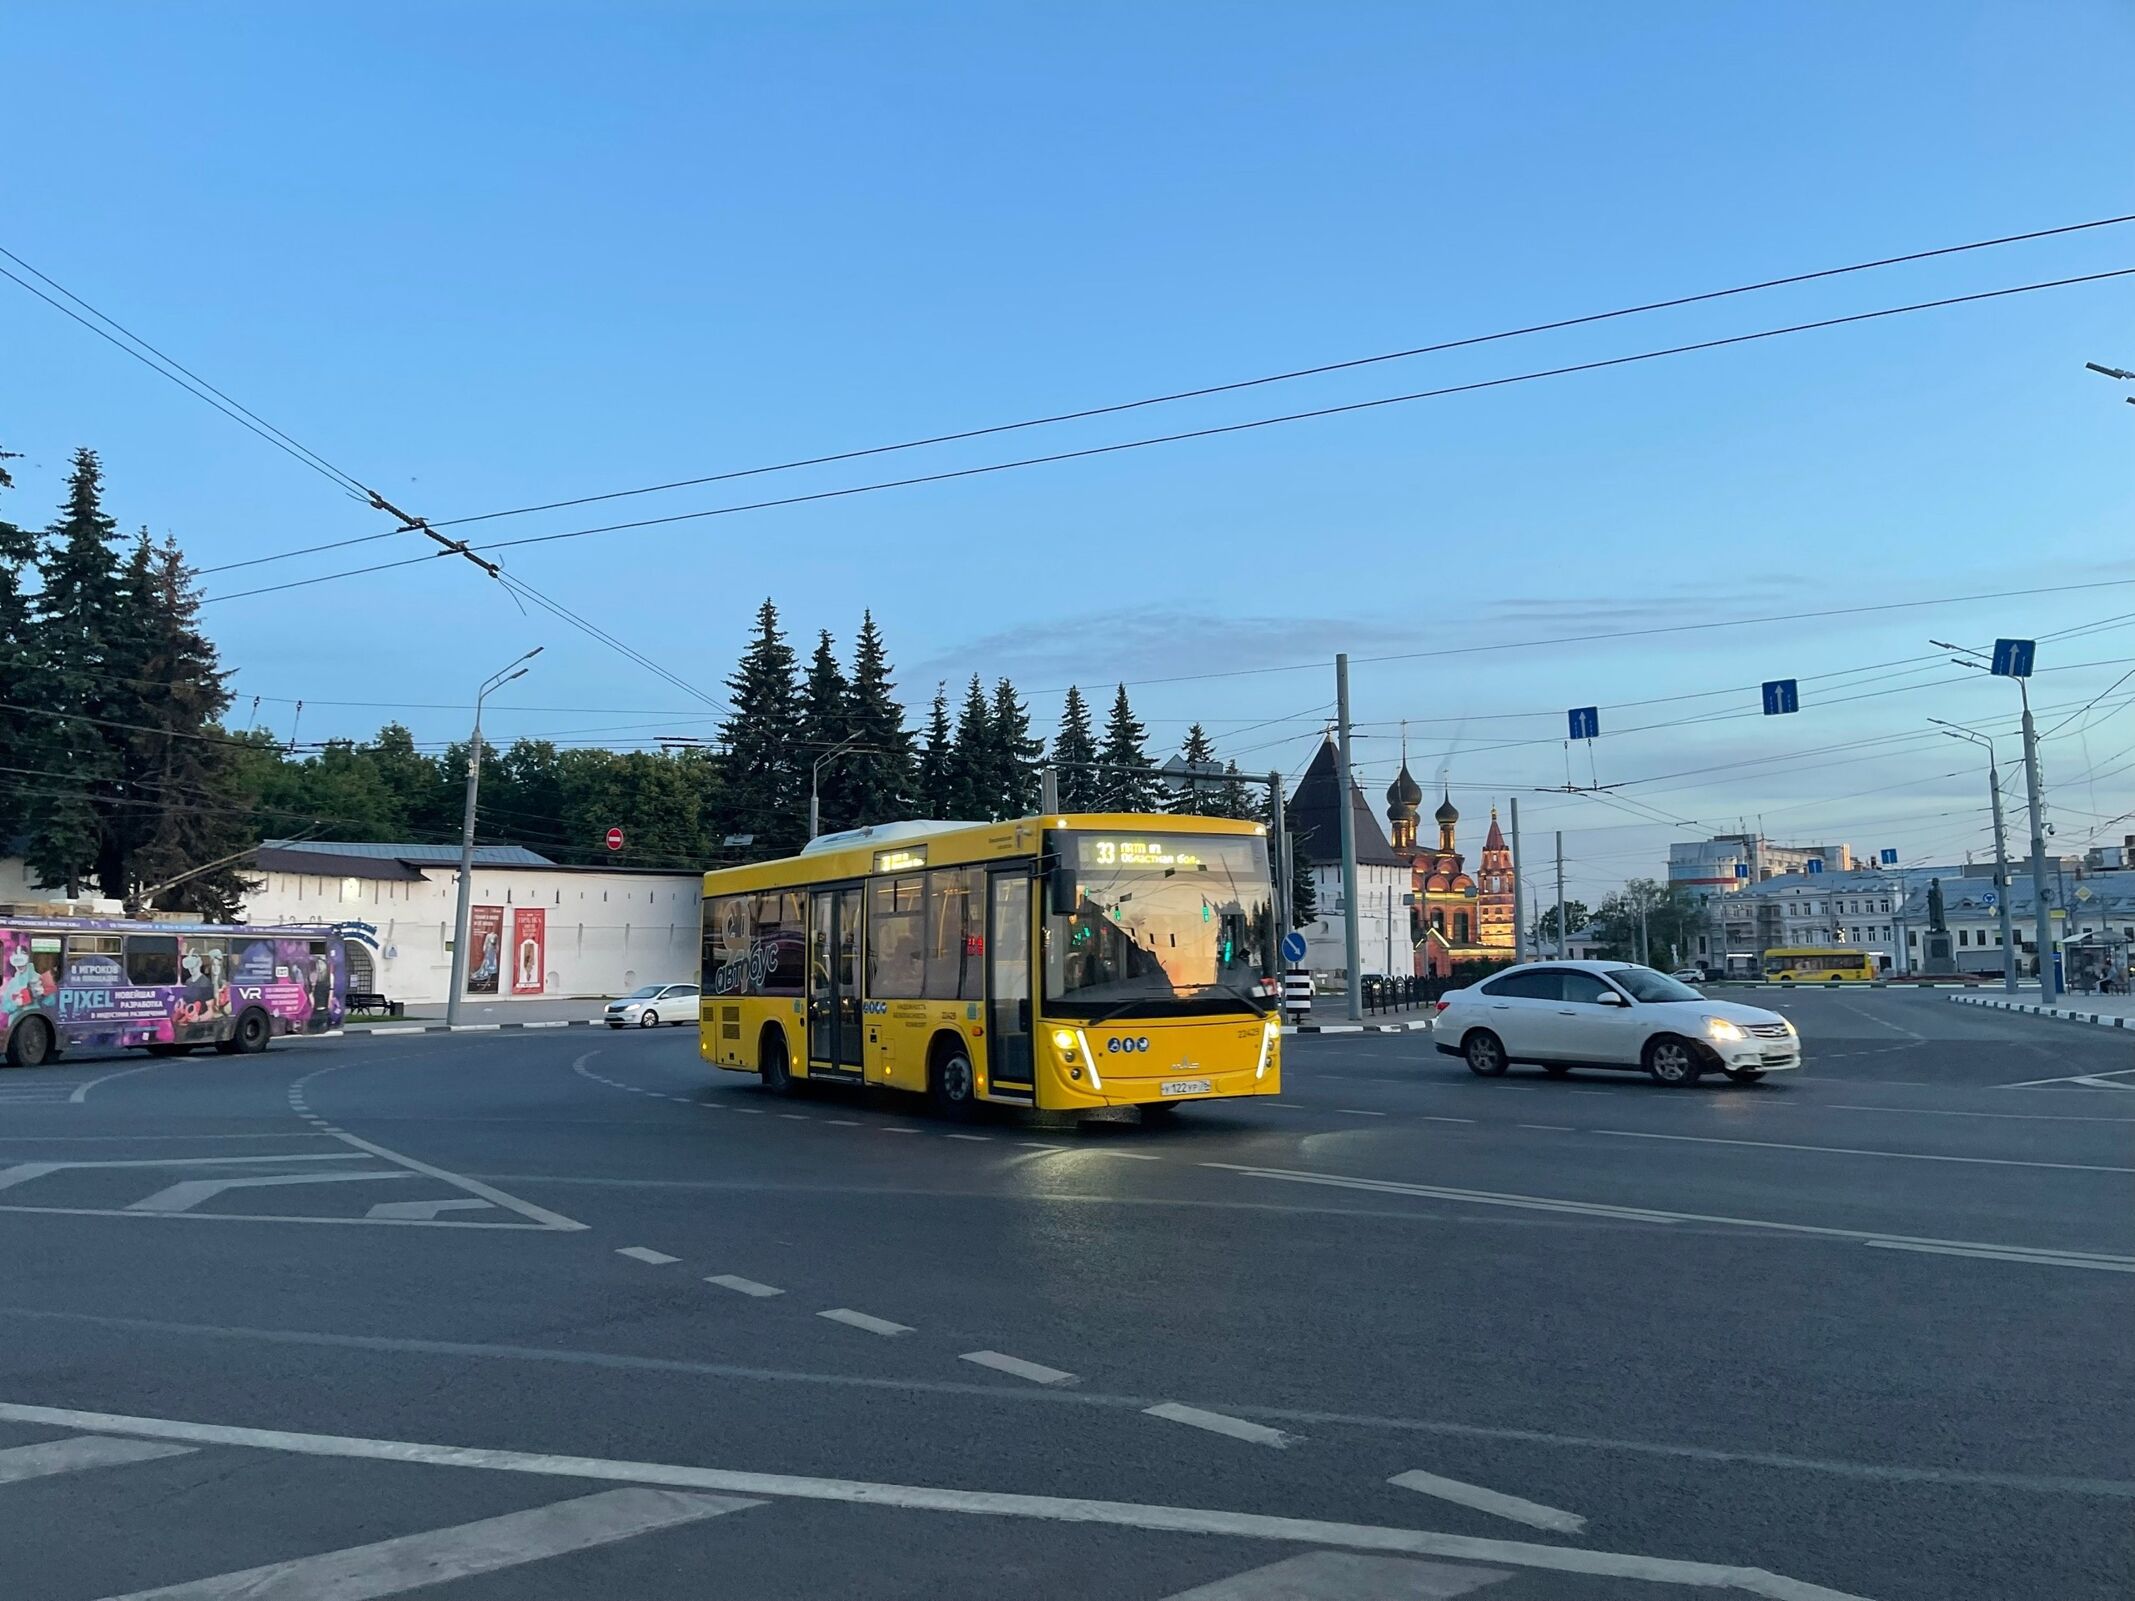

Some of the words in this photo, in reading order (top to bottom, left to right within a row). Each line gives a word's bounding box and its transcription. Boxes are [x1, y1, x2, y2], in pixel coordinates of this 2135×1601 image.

[1096, 842, 1115, 864] 33
[1120, 853, 1174, 864] Областная
[79, 965, 119, 974] ИГРОКОВ
[715, 940, 779, 994] автобус
[115, 990, 155, 999] НОВЕЙШАЯ
[239, 987, 261, 1000] VR
[59, 989, 114, 1013] PIXEL
[120, 1000, 163, 1009] РАЗРАБОТКА
